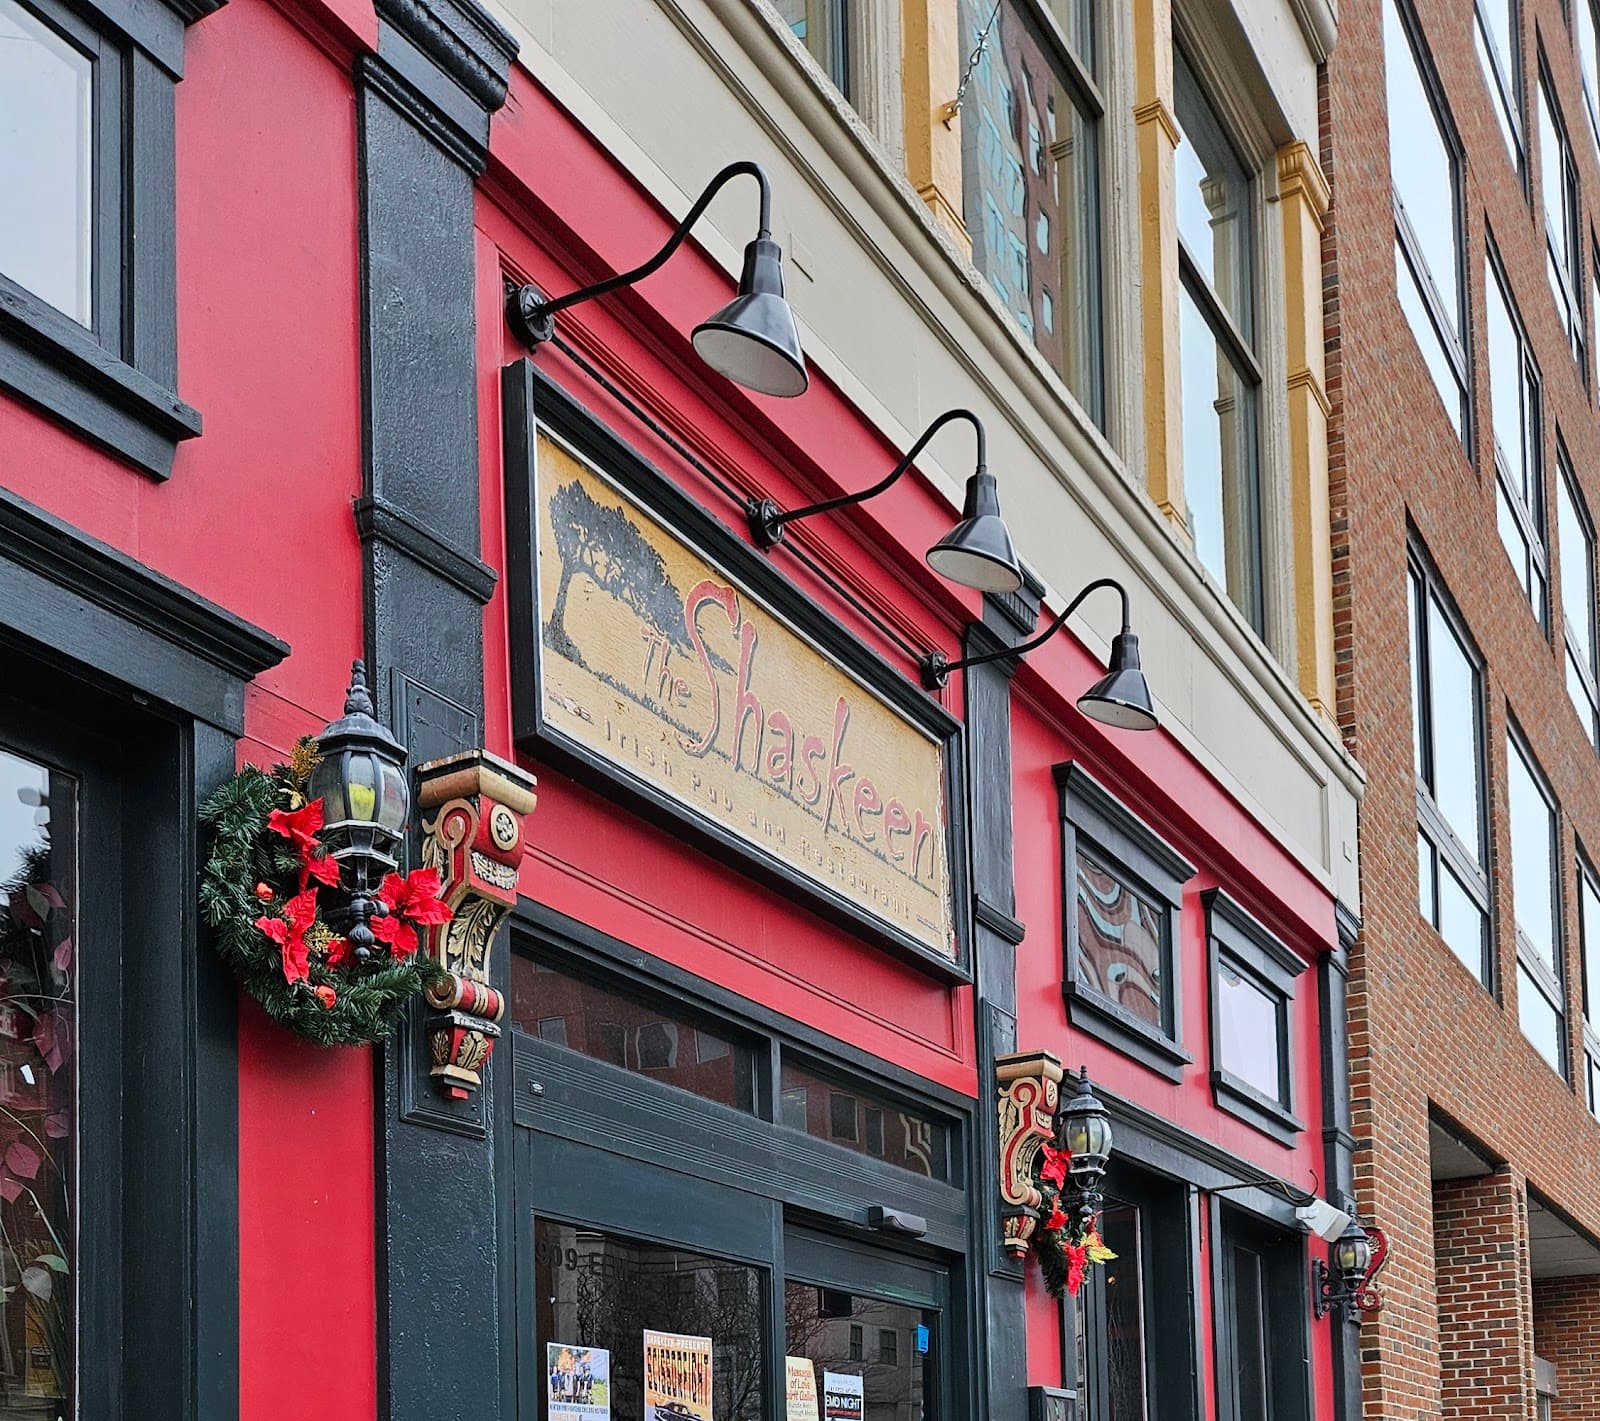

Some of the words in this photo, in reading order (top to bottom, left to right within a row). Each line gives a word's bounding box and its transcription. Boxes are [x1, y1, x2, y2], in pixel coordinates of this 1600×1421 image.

[639, 625, 692, 707] The
[672, 578, 934, 879] Shaskeen
[604, 714, 673, 778] Irish
[691, 769, 734, 813] Pub
[536, 1241, 578, 1272] 909
[826, 1394, 841, 1409] EMO
[841, 1396, 860, 1411] NIGHT
